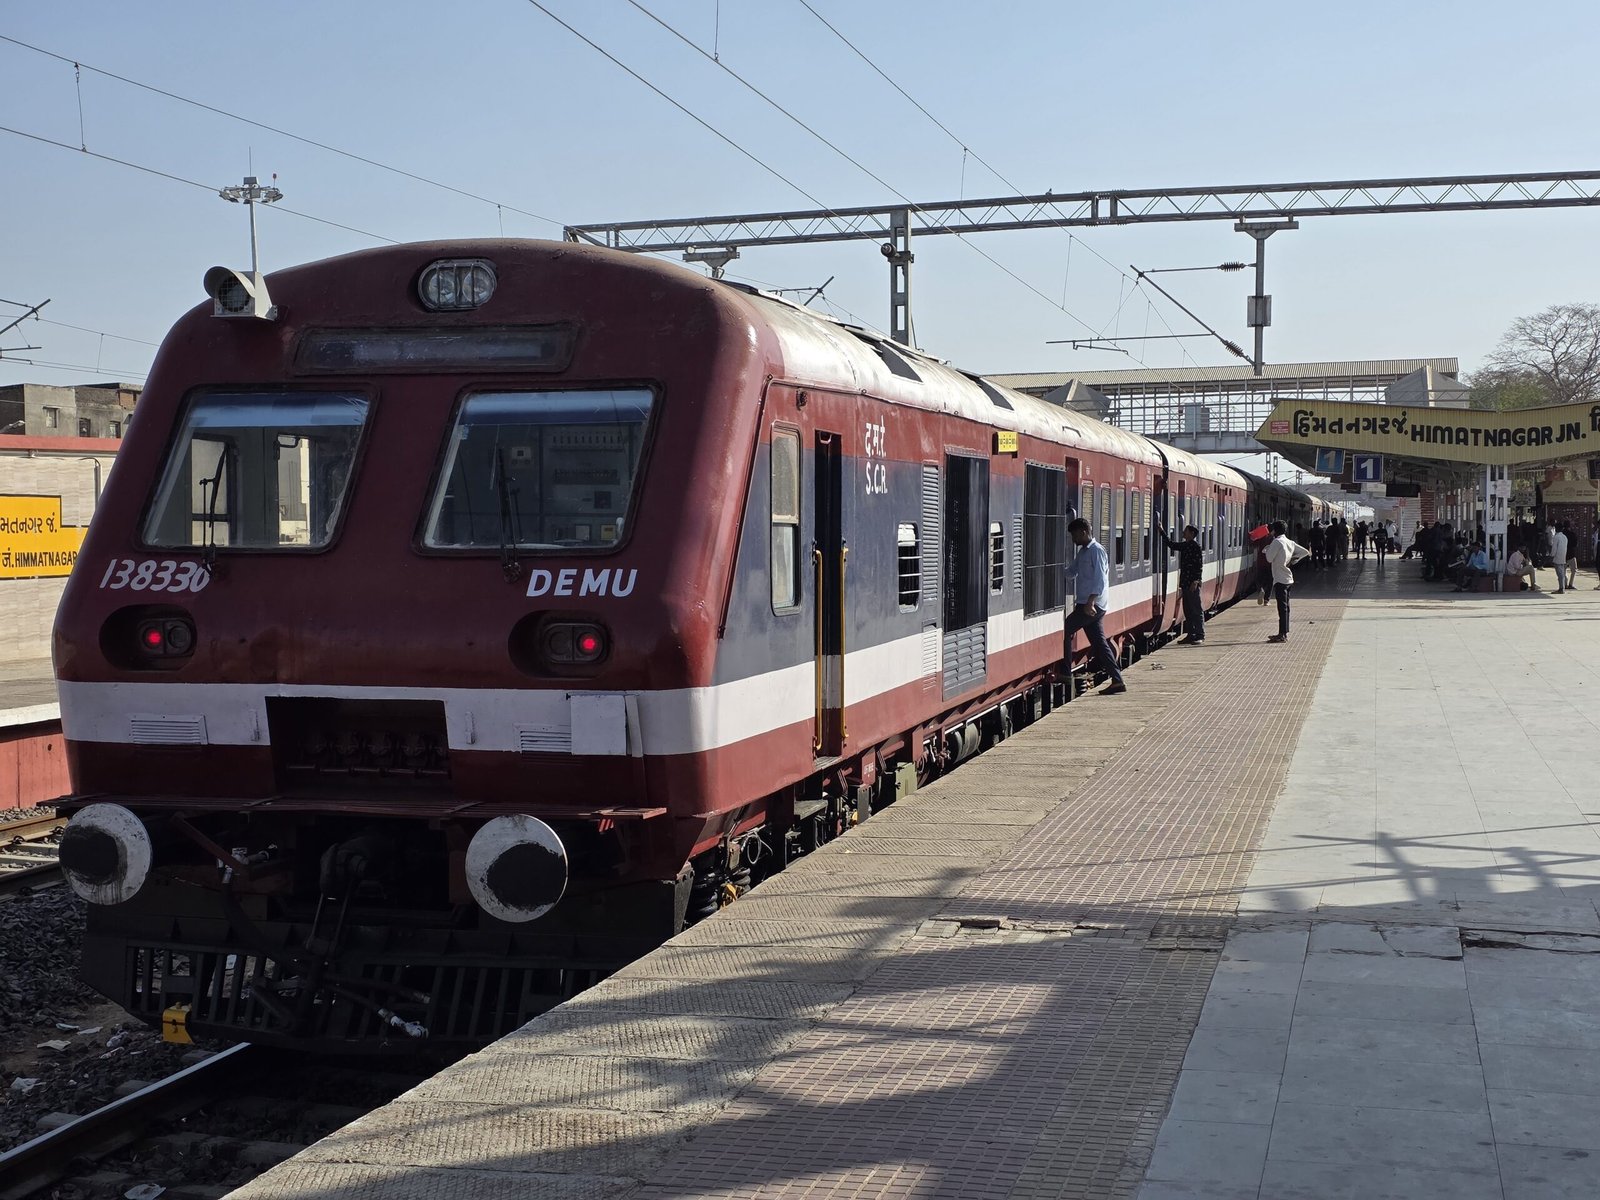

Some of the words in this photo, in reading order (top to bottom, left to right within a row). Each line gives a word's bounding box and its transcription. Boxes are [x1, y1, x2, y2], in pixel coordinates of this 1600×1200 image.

[1411, 424, 1553, 447] HIMATNAGAR
[1555, 421, 1587, 443] JN.
[1323, 450, 1336, 469] 1
[1360, 458, 1374, 479] 1
[99, 558, 212, 593] 138330
[526, 568, 638, 598] DEMU
